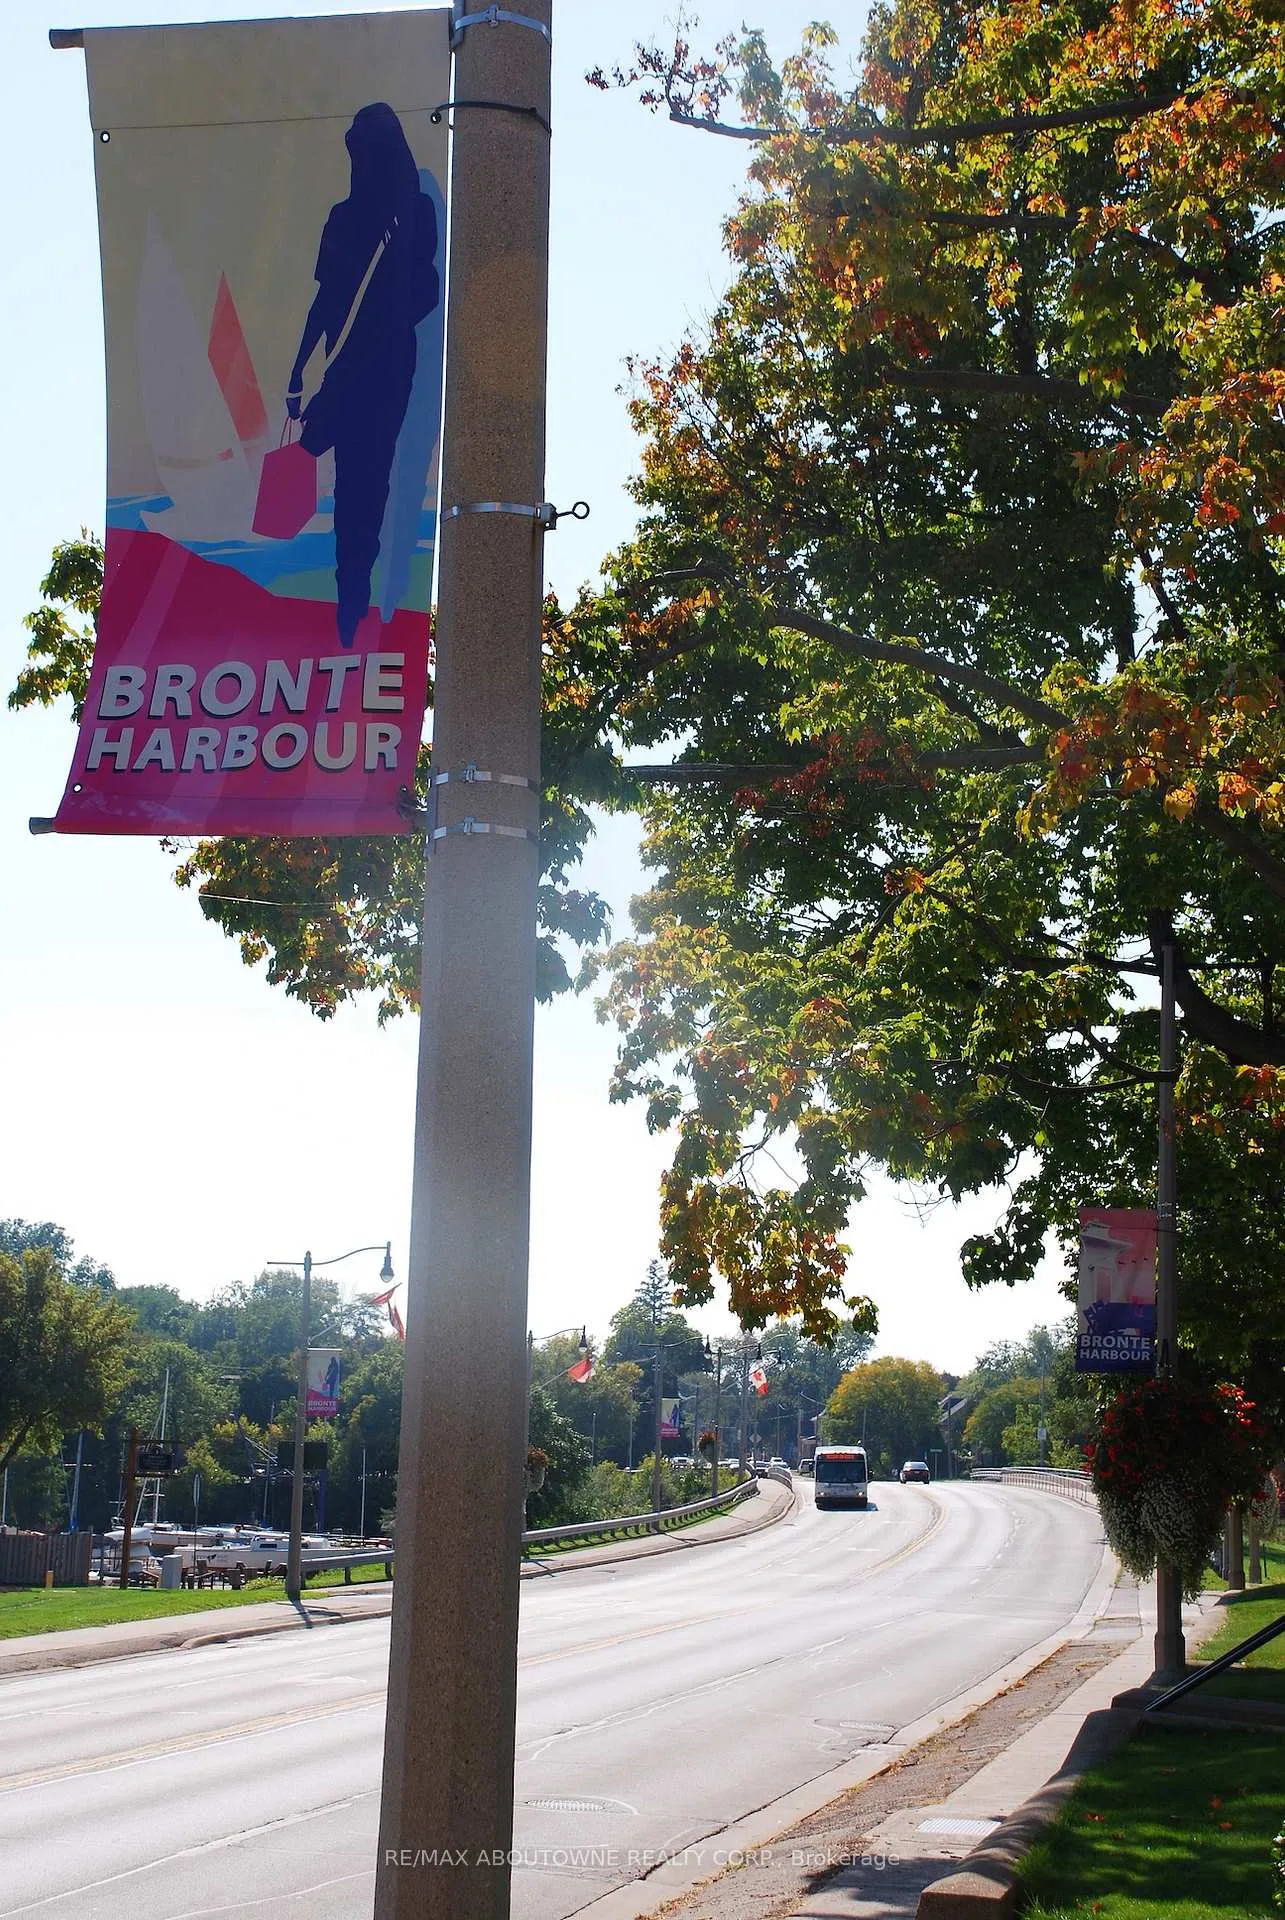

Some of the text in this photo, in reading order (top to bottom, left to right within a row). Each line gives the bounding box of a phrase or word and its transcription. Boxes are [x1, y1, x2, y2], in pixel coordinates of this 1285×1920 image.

[98, 652, 405, 719] BRONTE
[85, 721, 402, 772] HARBOUR
[1080, 1334, 1151, 1349] BRONTE
[1080, 1348, 1151, 1361] HARBOUR
